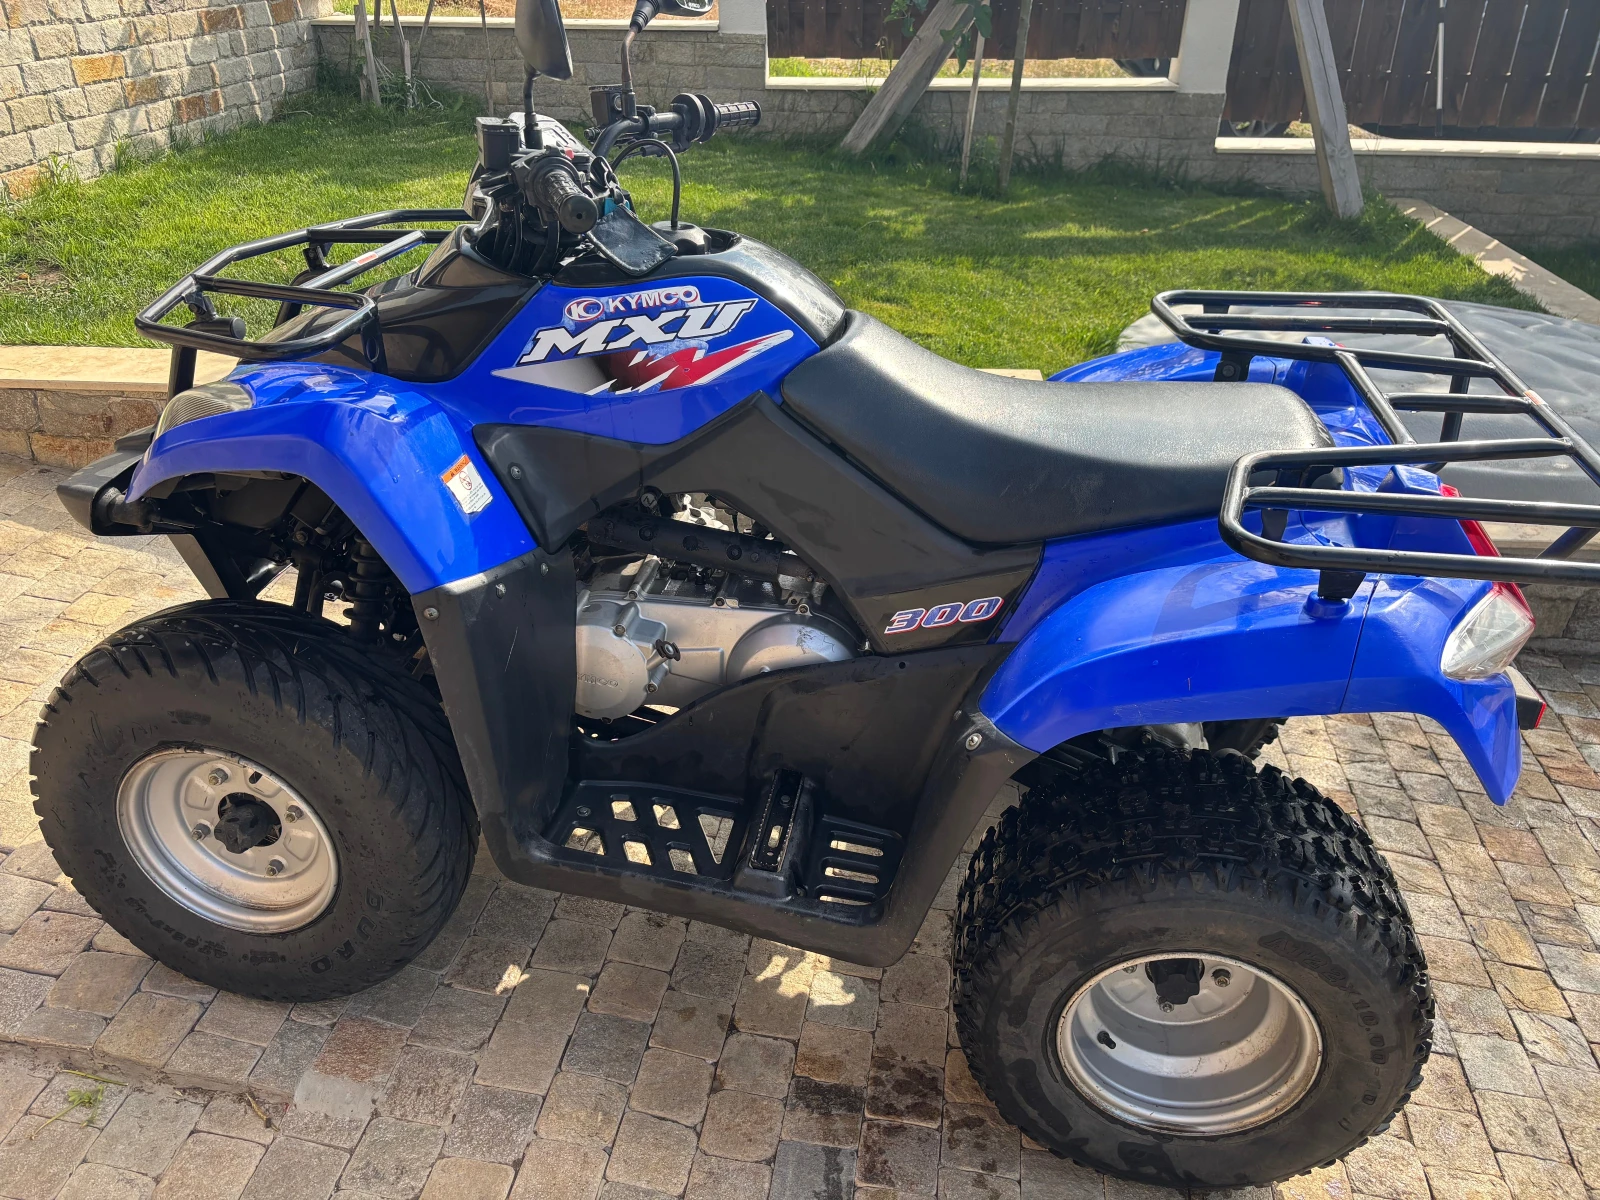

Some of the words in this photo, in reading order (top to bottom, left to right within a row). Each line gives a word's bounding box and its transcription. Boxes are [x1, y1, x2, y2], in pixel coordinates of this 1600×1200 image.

[608, 286, 700, 314] KYMCO
[518, 299, 758, 366] MXU
[884, 596, 1005, 635] 300
[577, 672, 619, 689] YMCO
[310, 888, 383, 974] DURO
